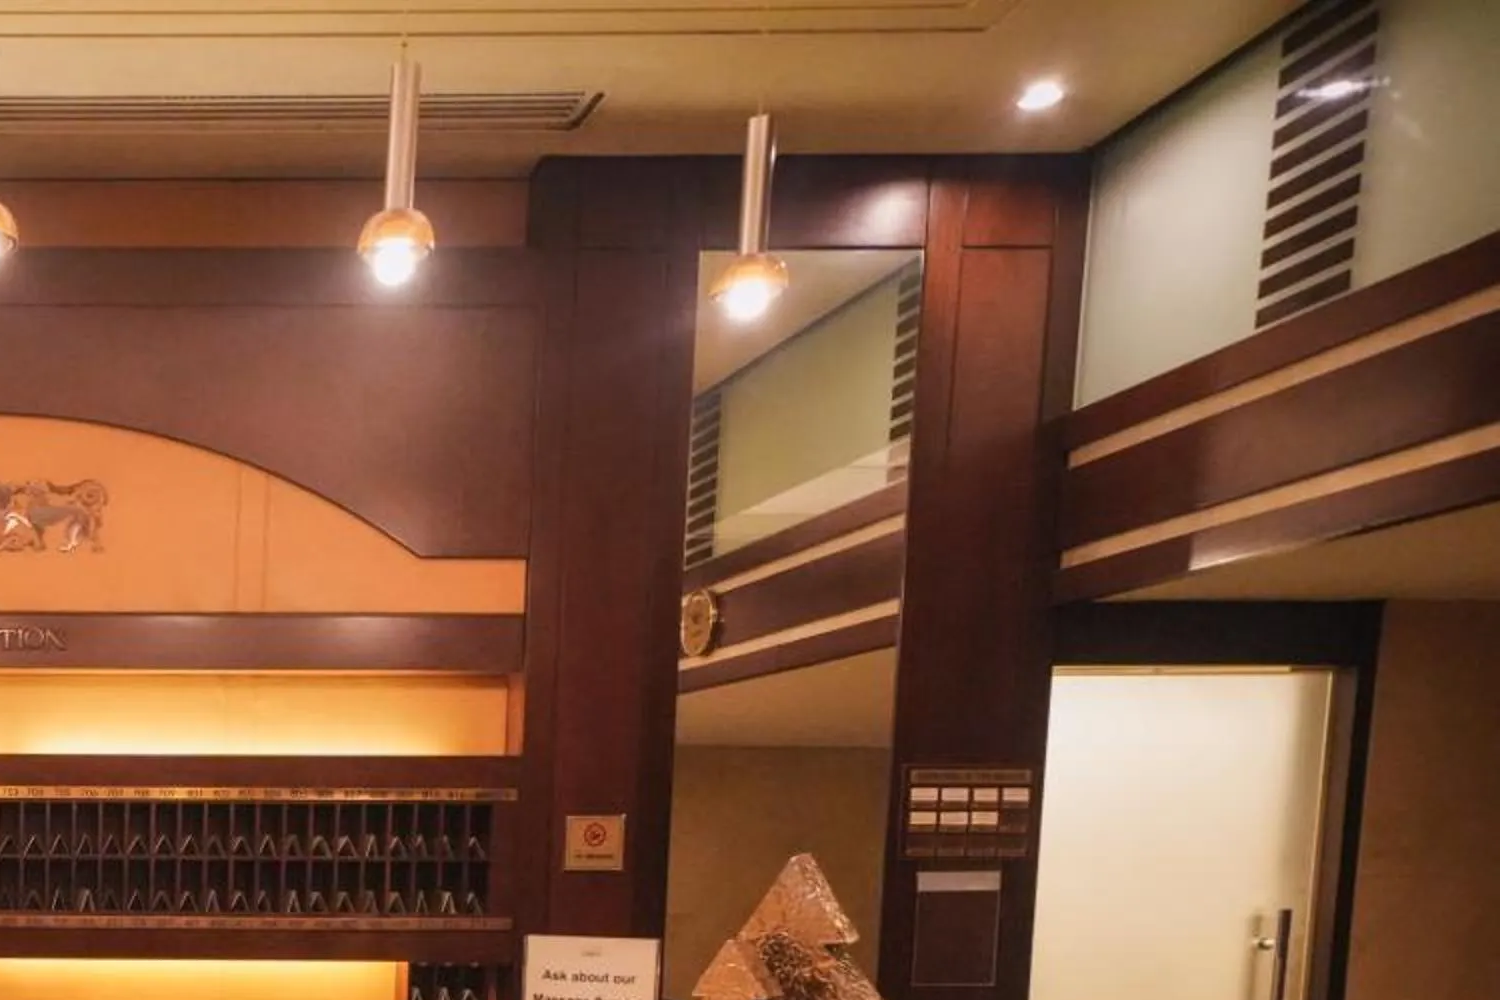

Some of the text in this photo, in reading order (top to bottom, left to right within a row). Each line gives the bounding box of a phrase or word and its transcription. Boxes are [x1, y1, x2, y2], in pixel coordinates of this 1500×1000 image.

[541, 970, 636, 984] Ask about our
